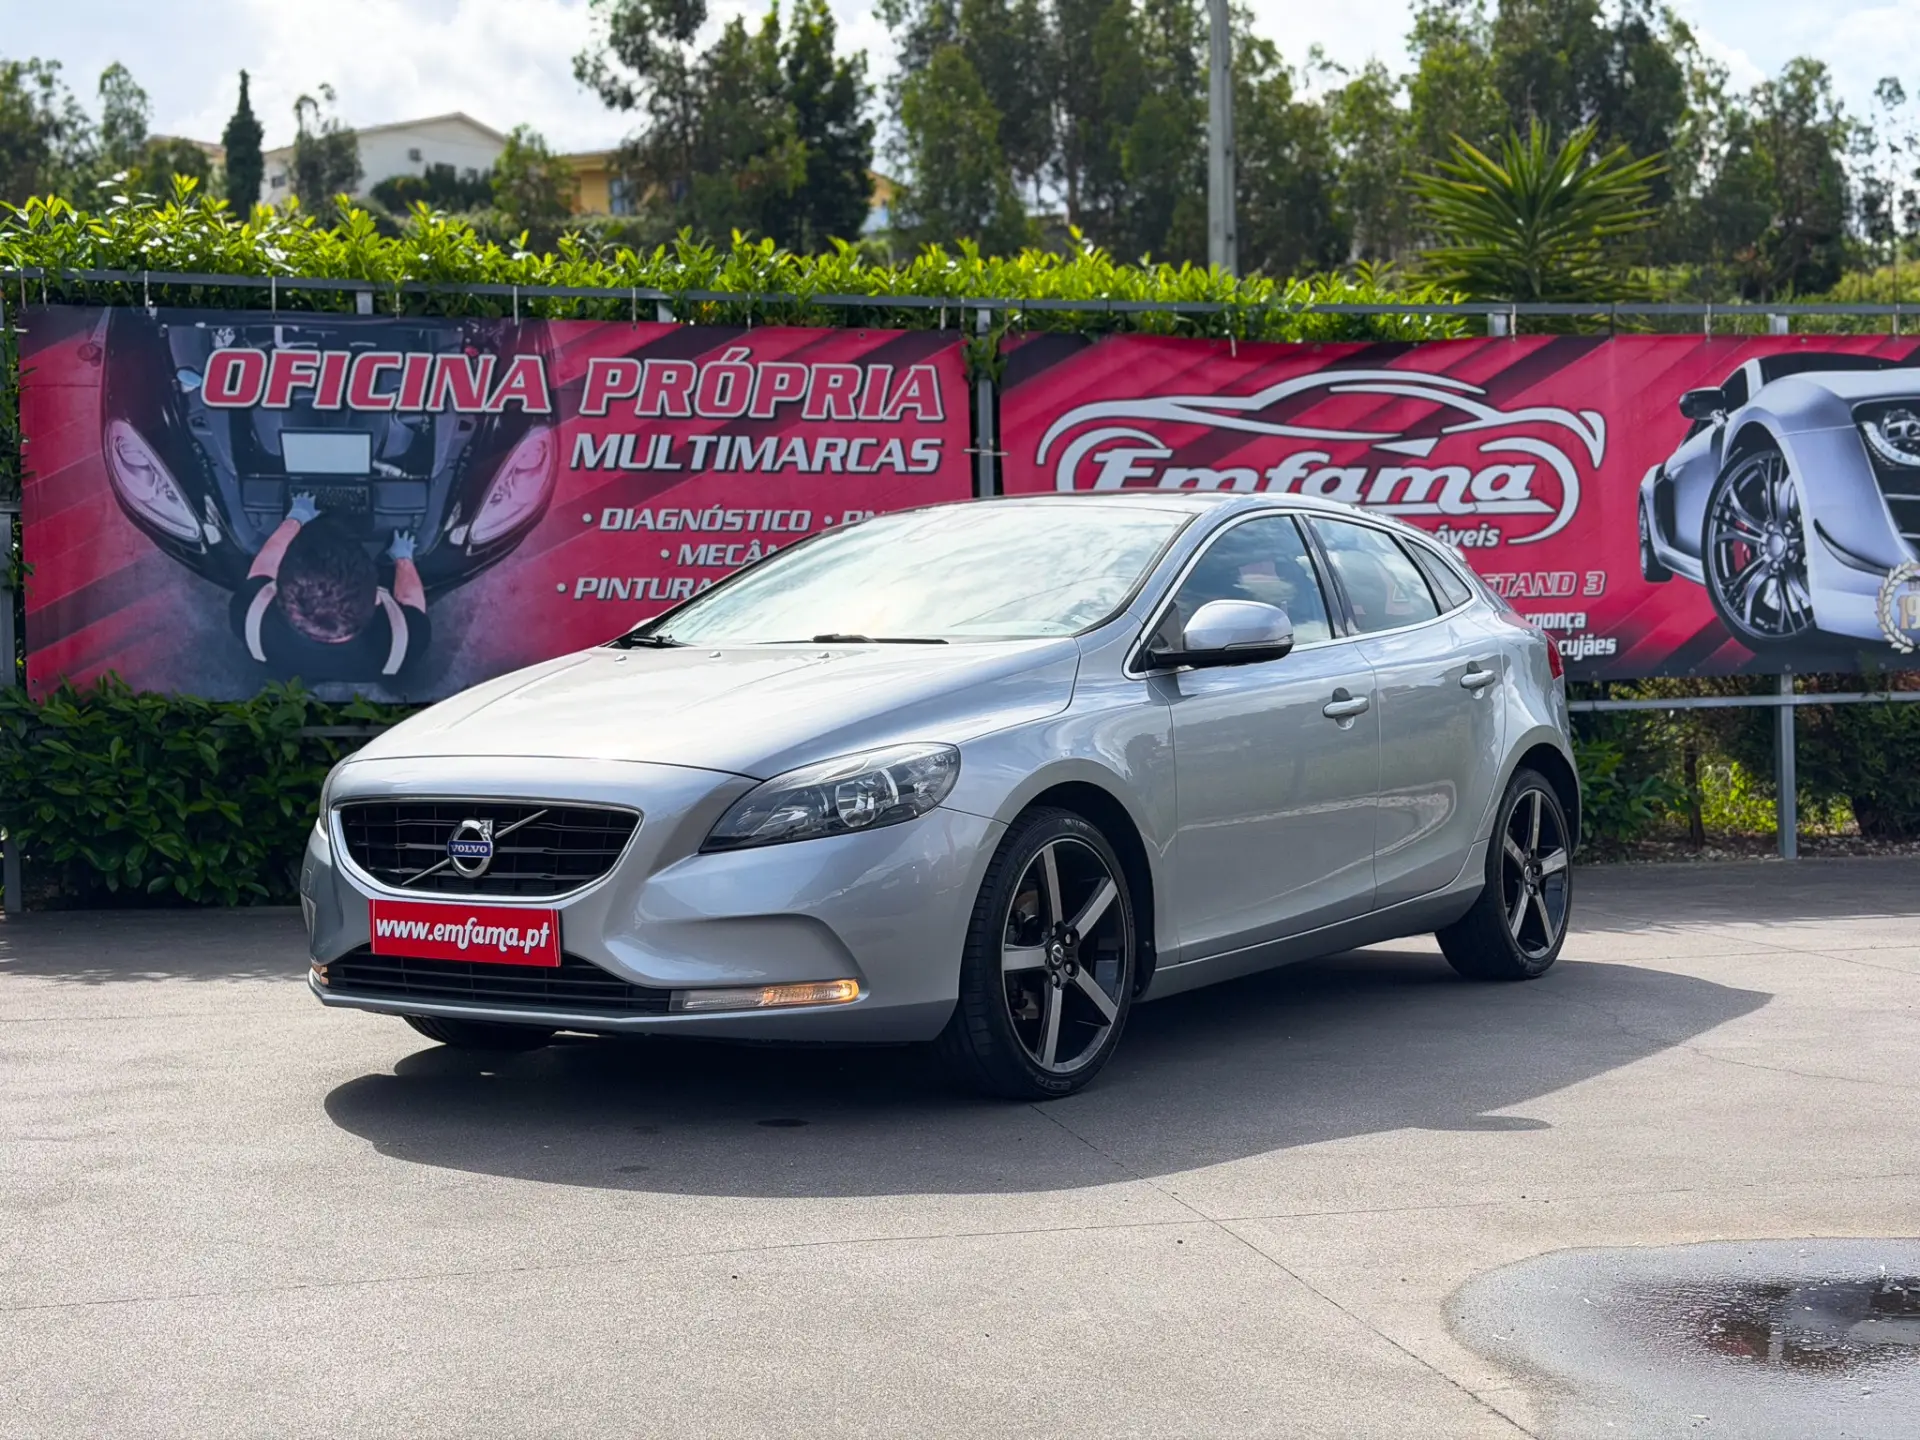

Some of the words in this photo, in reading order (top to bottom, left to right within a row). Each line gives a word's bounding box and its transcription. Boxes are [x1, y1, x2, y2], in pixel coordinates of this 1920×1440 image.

[202, 347, 552, 413] OFICINA
[578, 346, 945, 421] PRÓPRIA
[570, 432, 942, 473] MULTIMARCAS
[1093, 448, 1536, 514] Emfama
[599, 504, 811, 532] DIAGNÓSTICO
[1583, 570, 1606, 597] 3
[450, 843, 489, 854] VOLVO
[376, 916, 551, 954] www.emfama.pt
